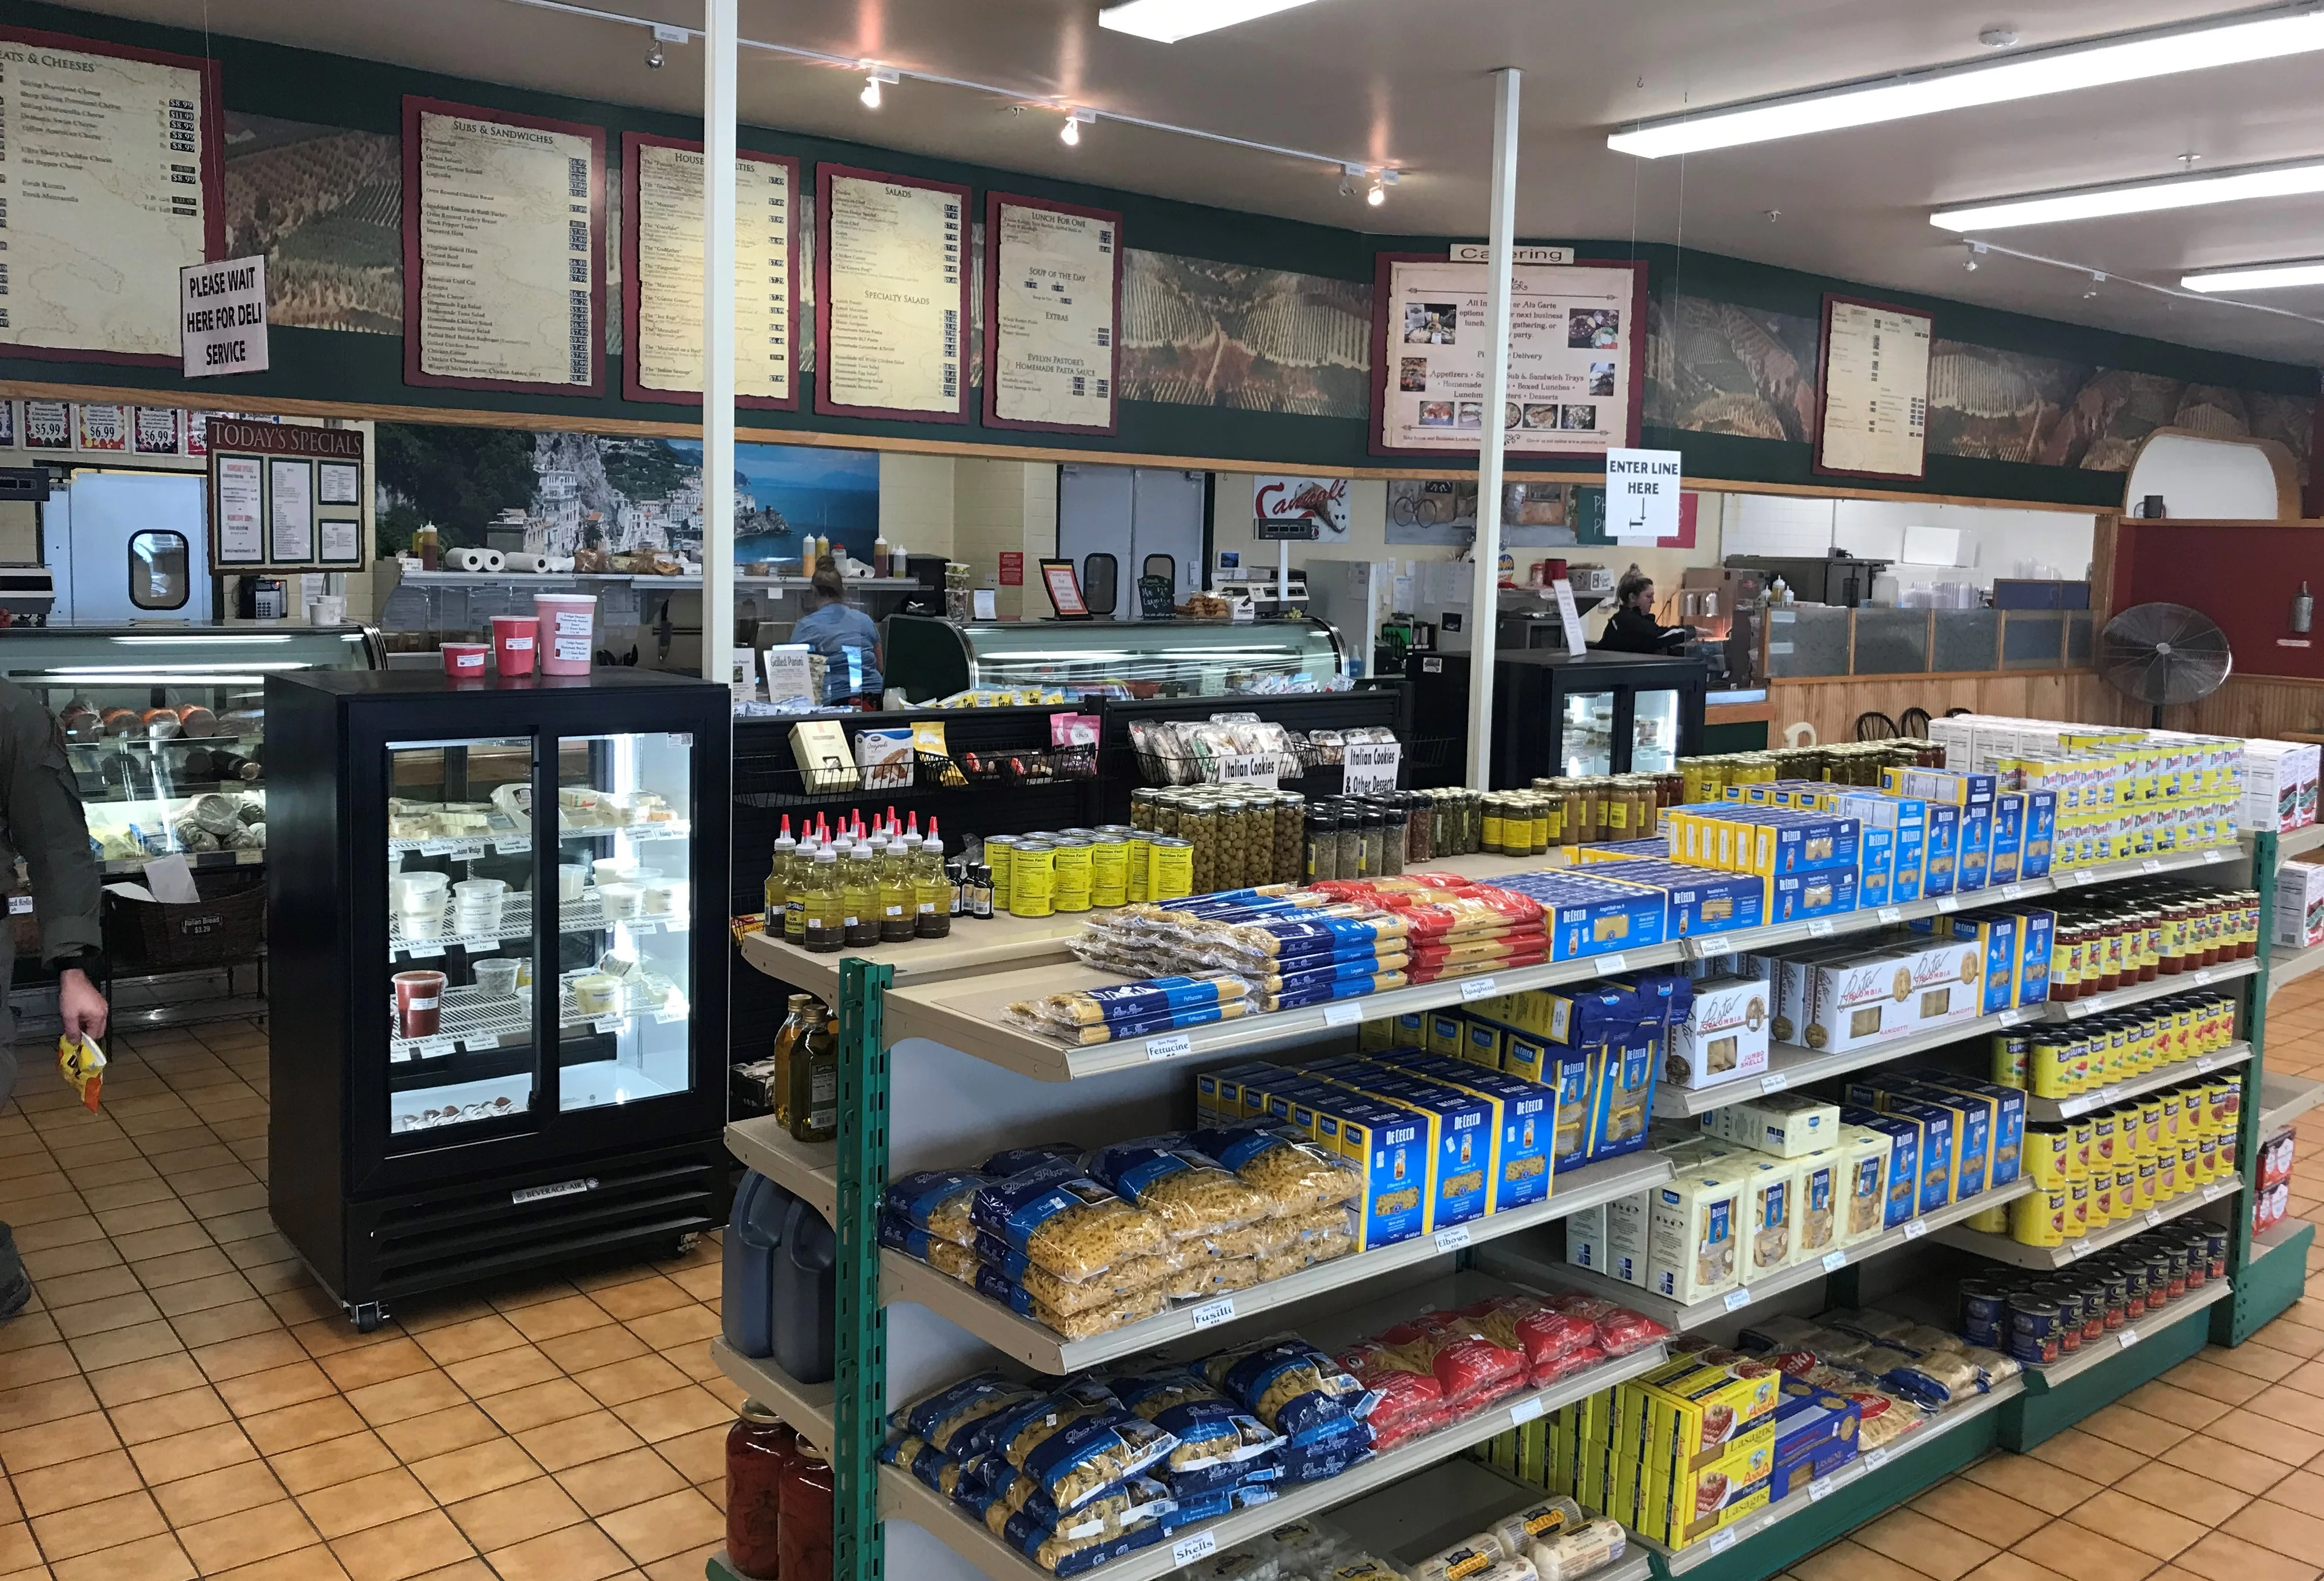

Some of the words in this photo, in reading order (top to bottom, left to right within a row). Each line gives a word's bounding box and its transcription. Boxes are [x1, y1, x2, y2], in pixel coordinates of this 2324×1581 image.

[28, 52, 37, 64] &
[41, 55, 95, 73] CHEESES
[170, 100, 193, 109] $8.99
[171, 122, 194, 131] $8.99
[453, 120, 477, 133] SUBS
[480, 124, 489, 135] &
[491, 126, 554, 145] SANDWICHES
[172, 133, 195, 141] $8.99
[172, 144, 195, 152] $8.99
[172, 174, 196, 183] $8.99
[885, 186, 912, 198] SALADS
[1032, 212, 1055, 223] LUNCH
[1057, 217, 1070, 225] FOR
[1072, 218, 1086, 228] ONE
[1461, 248, 1563, 262] Caering
[1029, 267, 1046, 277] SOUP
[1058, 272, 1071, 281] THE
[1073, 274, 1086, 282] DAY
[190, 272, 225, 299] PLEASE
[227, 266, 255, 290] WAIT
[865, 290, 902, 302] SPECIALTY
[904, 295, 930, 305] SALADS
[187, 310, 213, 333] HERE
[216, 307, 235, 330] FOR
[237, 303, 262, 326] DELI
[1046, 312, 1069, 322] EXTRAS
[1512, 322, 1547, 330] gathering,
[1514, 331, 1534, 339] party.
[206, 340, 246, 366] SERVICE
[1028, 353, 1051, 363] EVELYN
[1053, 356, 1084, 366] PASTORE'S
[1512, 352, 1543, 361] Delivery
[1016, 361, 1054, 372] HOMEMADE
[1056, 366, 1075, 375] PASTA
[1076, 368, 1096, 376] SAUCE
[1429, 370, 1469, 379] Appetizers
[1529, 373, 1563, 381] Sandwich
[1443, 380, 1482, 388] Homemade
[35, 423, 61, 436] $5.99
[90, 426, 115, 439] $6.99
[145, 430, 168, 442] $6.99
[211, 421, 286, 450] TODAY'S
[290, 429, 361, 455] SPECIALS
[1609, 460, 1648, 475] ENTER
[1651, 462, 1678, 475] LINE
[1627, 481, 1659, 495] HERE
[1255, 478, 1348, 518] Cannoli
[771, 655, 787, 667] Grilled
[788, 656, 803, 667] Panini
[867, 741, 888, 751] Originals
[1350, 748, 1372, 766] Italian
[1374, 746, 1395, 765] Cookies
[1225, 760, 1248, 779] Italian
[1250, 759, 1274, 776] Cookies
[1346, 776, 1351, 793] &
[1353, 775, 1371, 793] Other
[1373, 775, 1394, 792] Desserts
[1465, 984, 1496, 997] Spaghetti
[1948, 1006, 1975, 1016] MANICOTTI
[1880, 1025, 1908, 1036] MANICOTTI
[1149, 1042, 1189, 1055] Fettucine
[1741, 1056, 1764, 1068] SHELLS
[1744, 1051, 1764, 1062] JUMBO
[1438, 1233, 1469, 1246] Elbows
[1195, 1306, 1232, 1323] Fusilli
[1730, 1424, 1774, 1452] Lasagne
[1725, 1490, 1770, 1520] Lasagne
[1526, 1510, 1564, 1533] POLENTA
[1176, 1540, 1214, 1560] Shells
[1448, 1553, 1487, 1579] POLENTA
